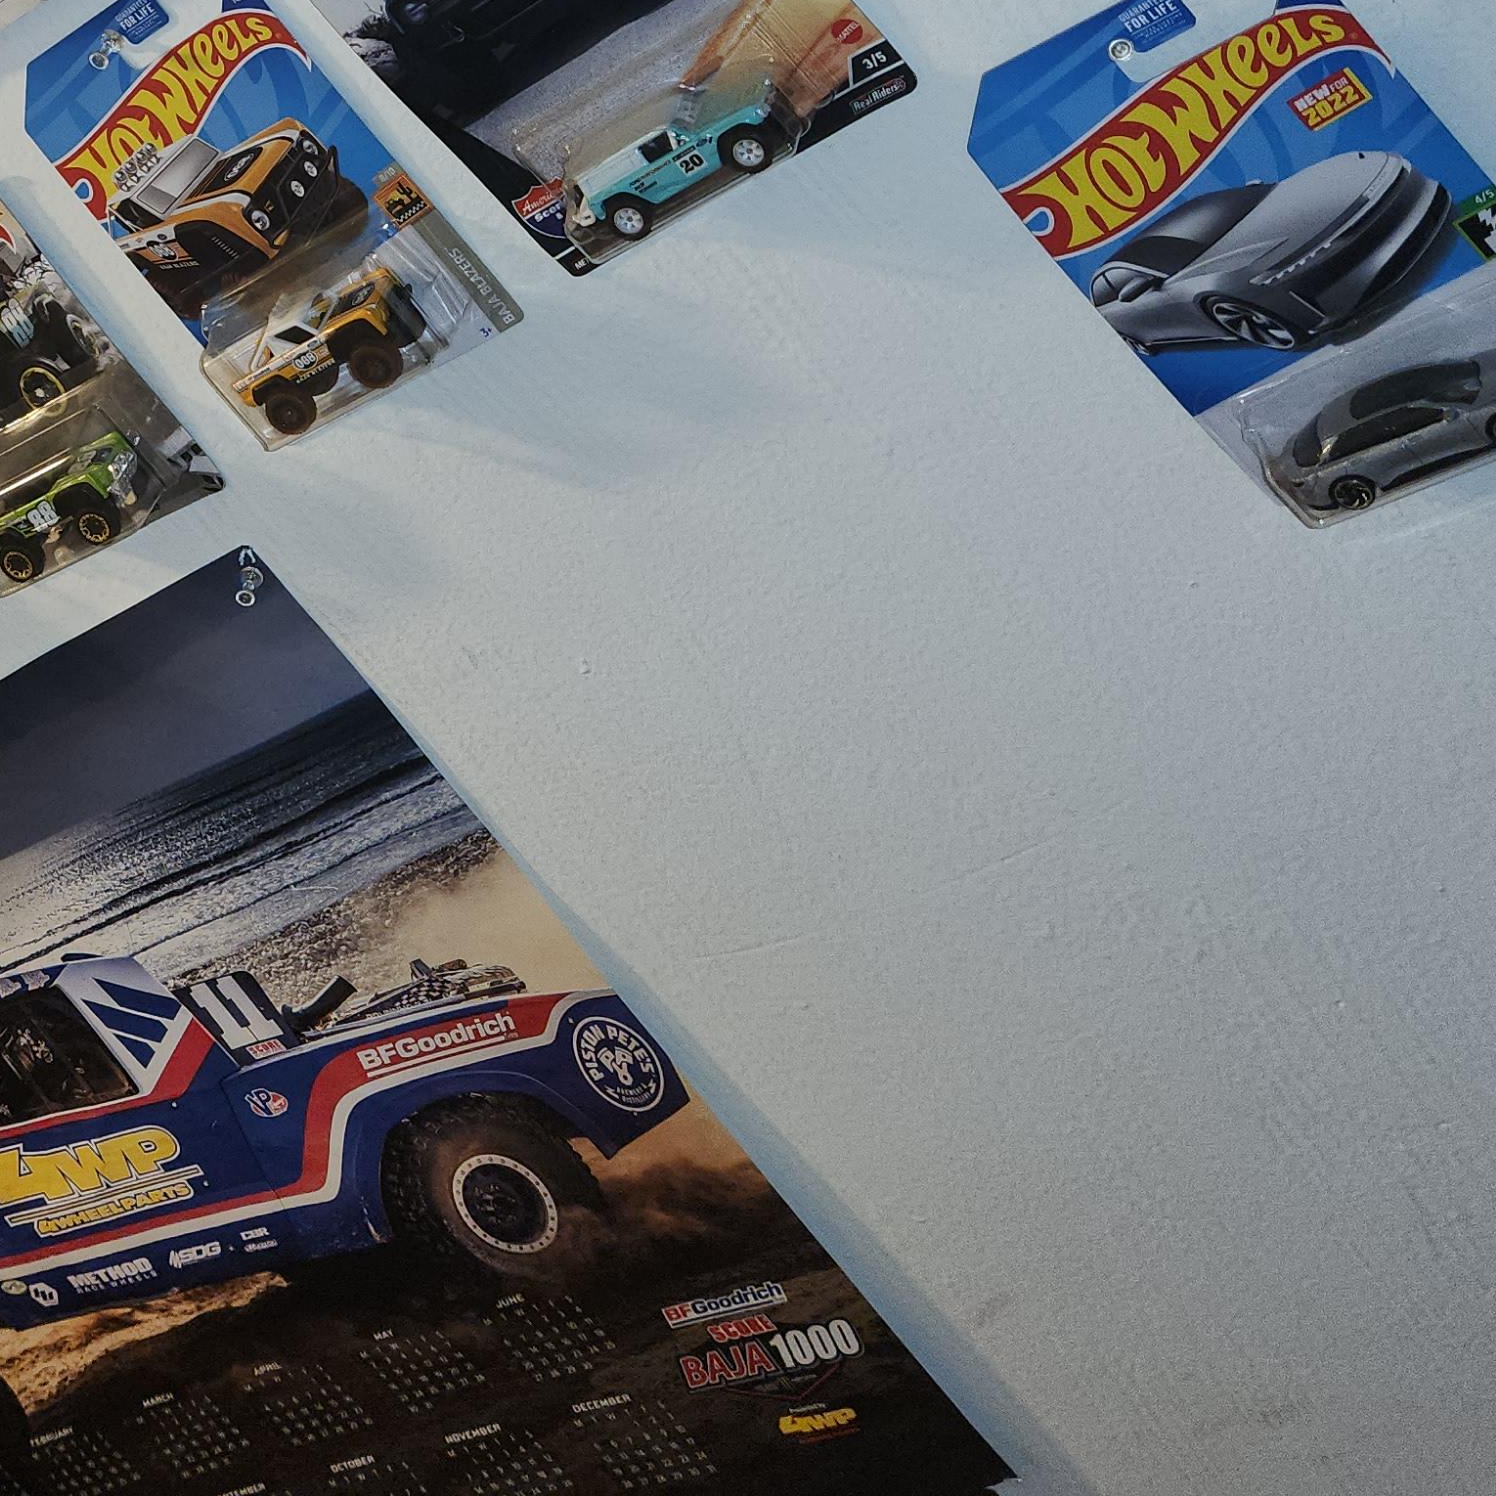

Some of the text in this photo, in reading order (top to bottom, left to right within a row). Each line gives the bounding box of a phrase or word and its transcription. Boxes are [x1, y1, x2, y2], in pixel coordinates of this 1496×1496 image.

[119, 2, 155, 34] FOR LIFE
[1124, 0, 1178, 33] FOR LIFE
[835, 21, 861, 43] MATTEL
[861, 50, 888, 71] 3/5
[1295, 76, 1349, 112] NEW FOR
[1303, 88, 1359, 126] 2022
[678, 152, 704, 174] 20
[1474, 189, 1496, 204] 4/5
[188, 976, 285, 1050] 11
[246, 1040, 284, 1058] SCORE
[356, 1010, 516, 1071] BFGoodrich
[581, 1025, 655, 1081] PISTON PETE'S
[67, 1257, 154, 1290] METHOD
[663, 1281, 785, 1323] BFGoodrich
[373, 1329, 394, 1341] MAY
[707, 1314, 776, 1343] SCORE
[680, 1319, 860, 1388] BAJA 1000
[571, 1393, 633, 1413] DECEMBER
[445, 1422, 501, 1444] NOVEMBER
[330, 1455, 375, 1473] OCTOBER
